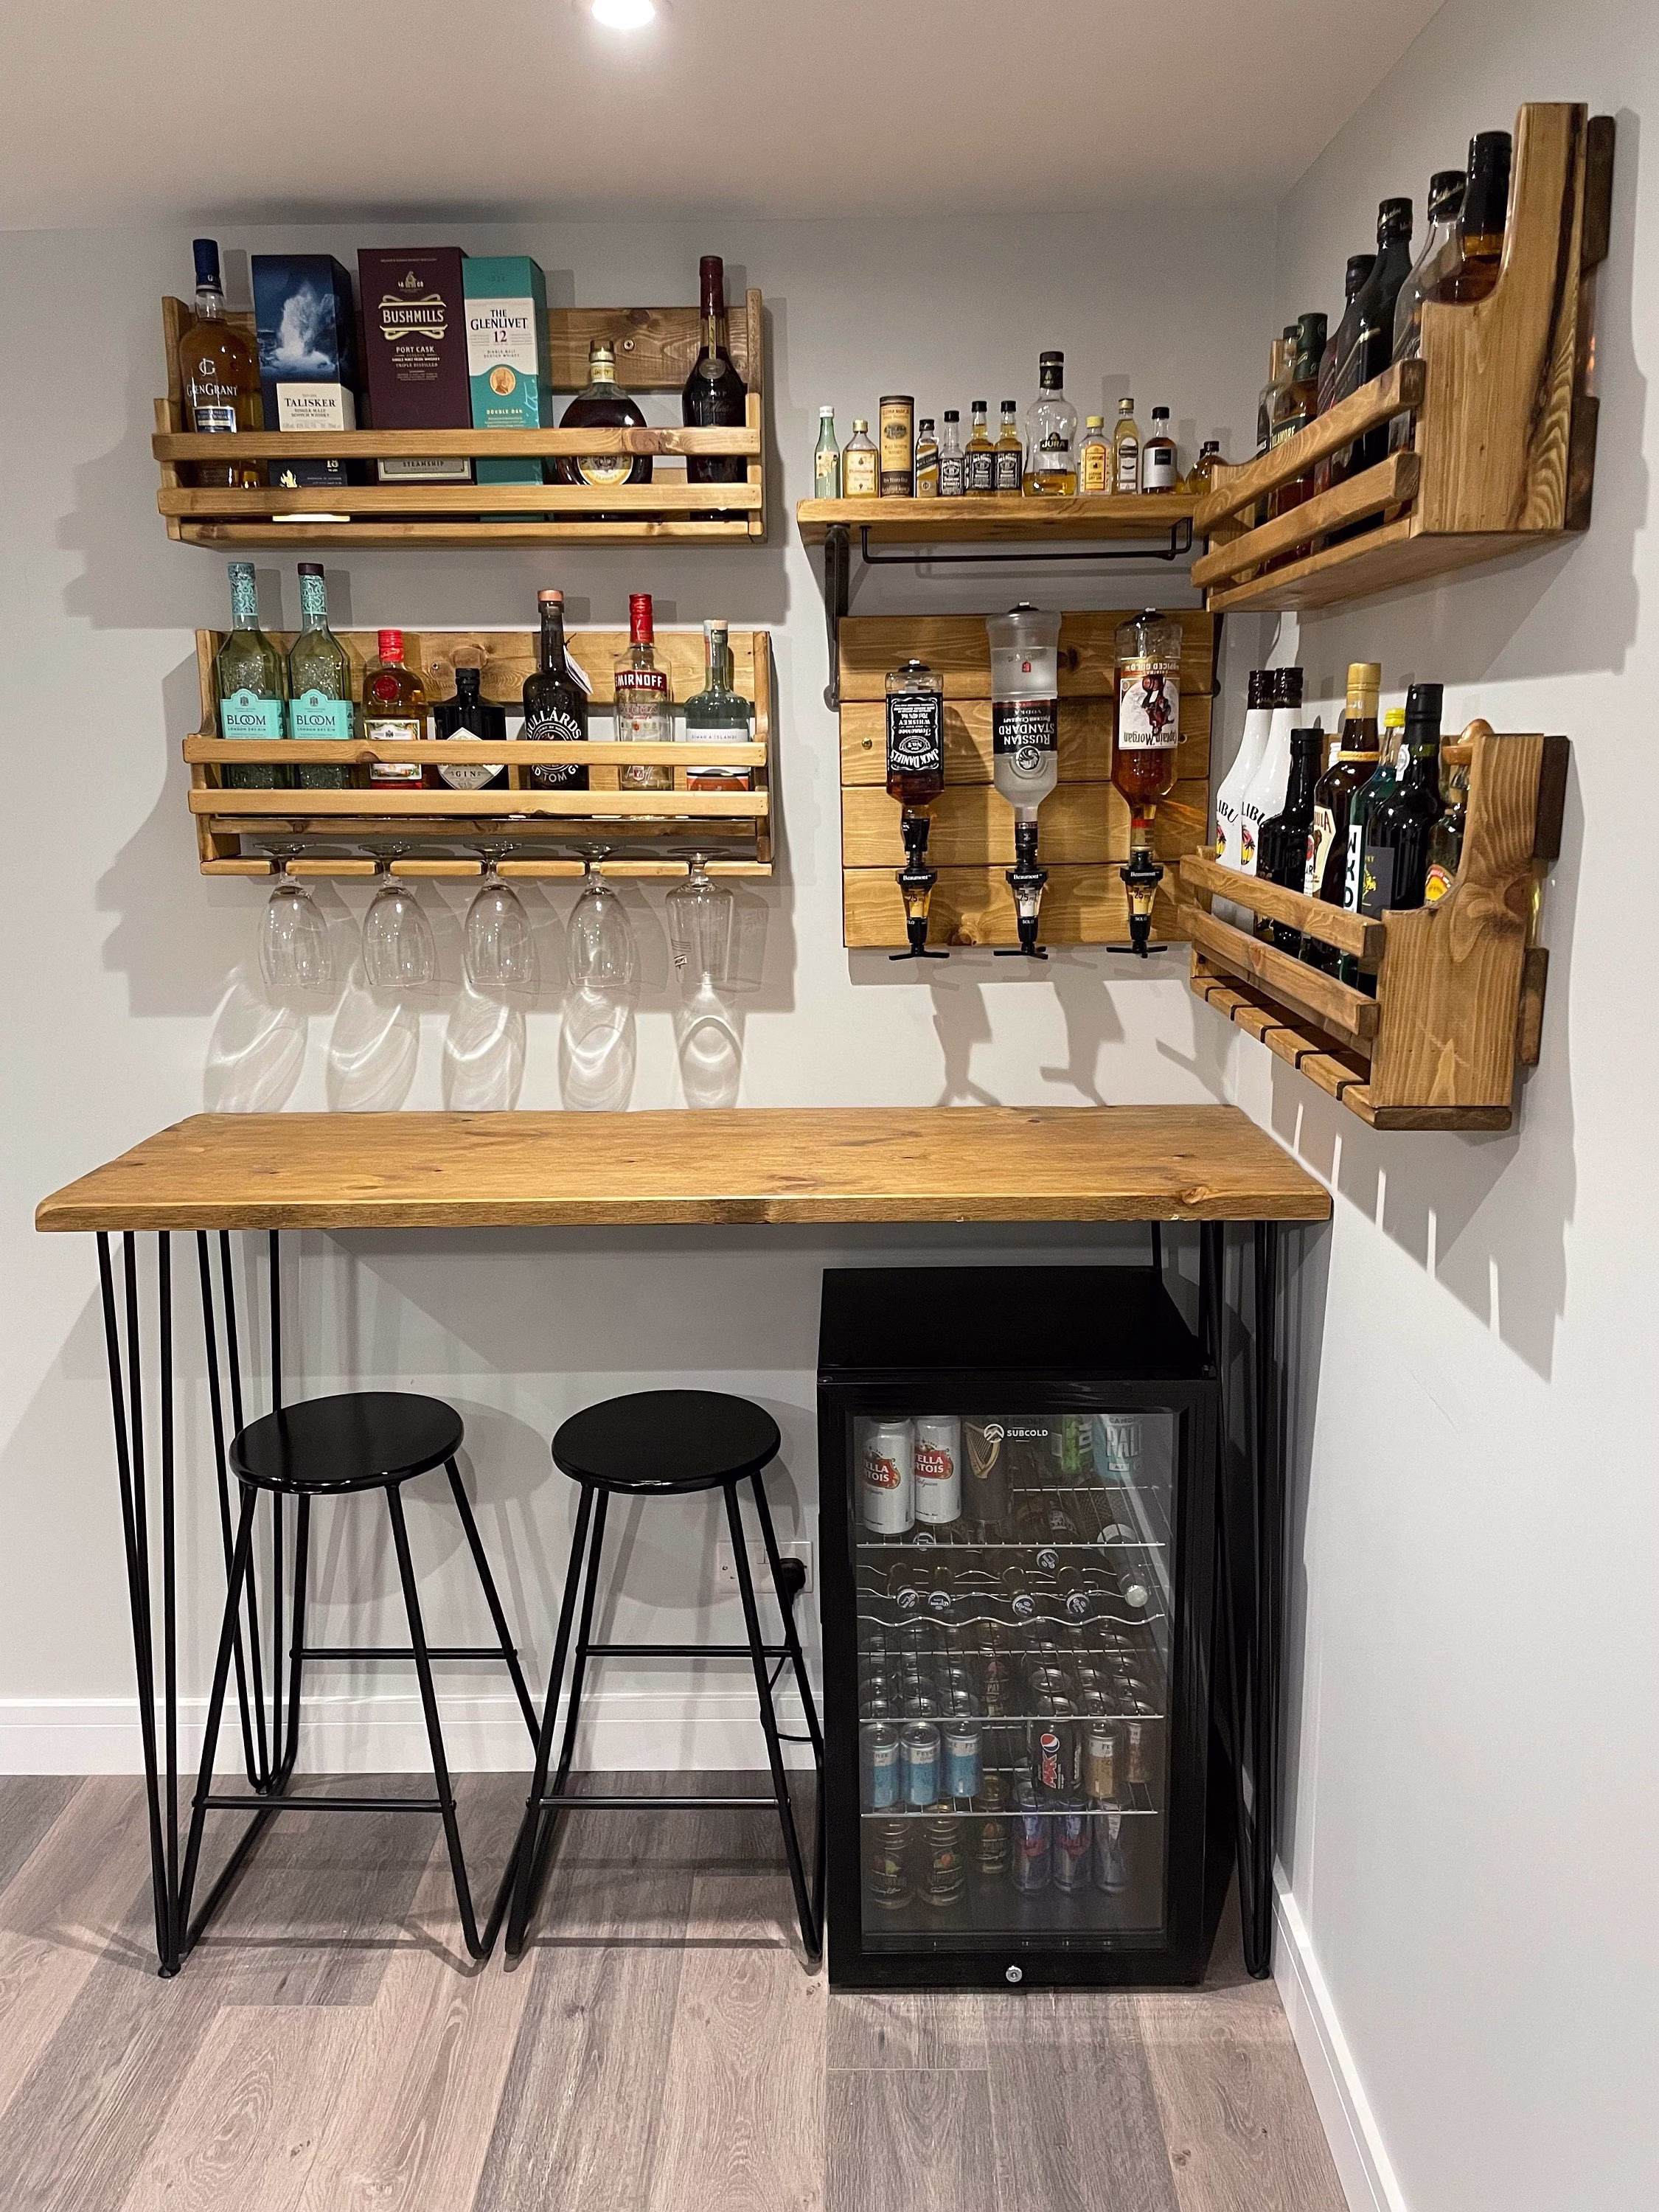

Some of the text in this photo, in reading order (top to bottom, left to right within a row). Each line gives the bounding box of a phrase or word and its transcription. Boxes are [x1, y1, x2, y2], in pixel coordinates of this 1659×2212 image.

[383, 310, 444, 324] BUSHMILLS
[490, 309, 507, 318] THE
[470, 318, 528, 330] GLENLIVET
[494, 330, 507, 343] 12
[285, 398, 336, 407] TALISKER
[1041, 440, 1065, 448] JURA
[227, 714, 266, 726] BLOOM
[296, 714, 335, 726] BLOOM
[526, 709, 582, 740] BULLARDS
[998, 723, 1054, 735] STANDARD
[1004, 734, 1050, 745] RUSSIAN
[1124, 731, 1155, 745] Morgan
[889, 748, 939, 768] JACK DANIEL'S
[543, 771, 568, 782] TOM
[1006, 1429, 1048, 1437] SUBCOLD
[915, 1453, 944, 1464] ELLA
[866, 1461, 889, 1473] ELLA
[915, 1462, 944, 1473] RTOIS
[866, 1470, 890, 1482] TOIS
